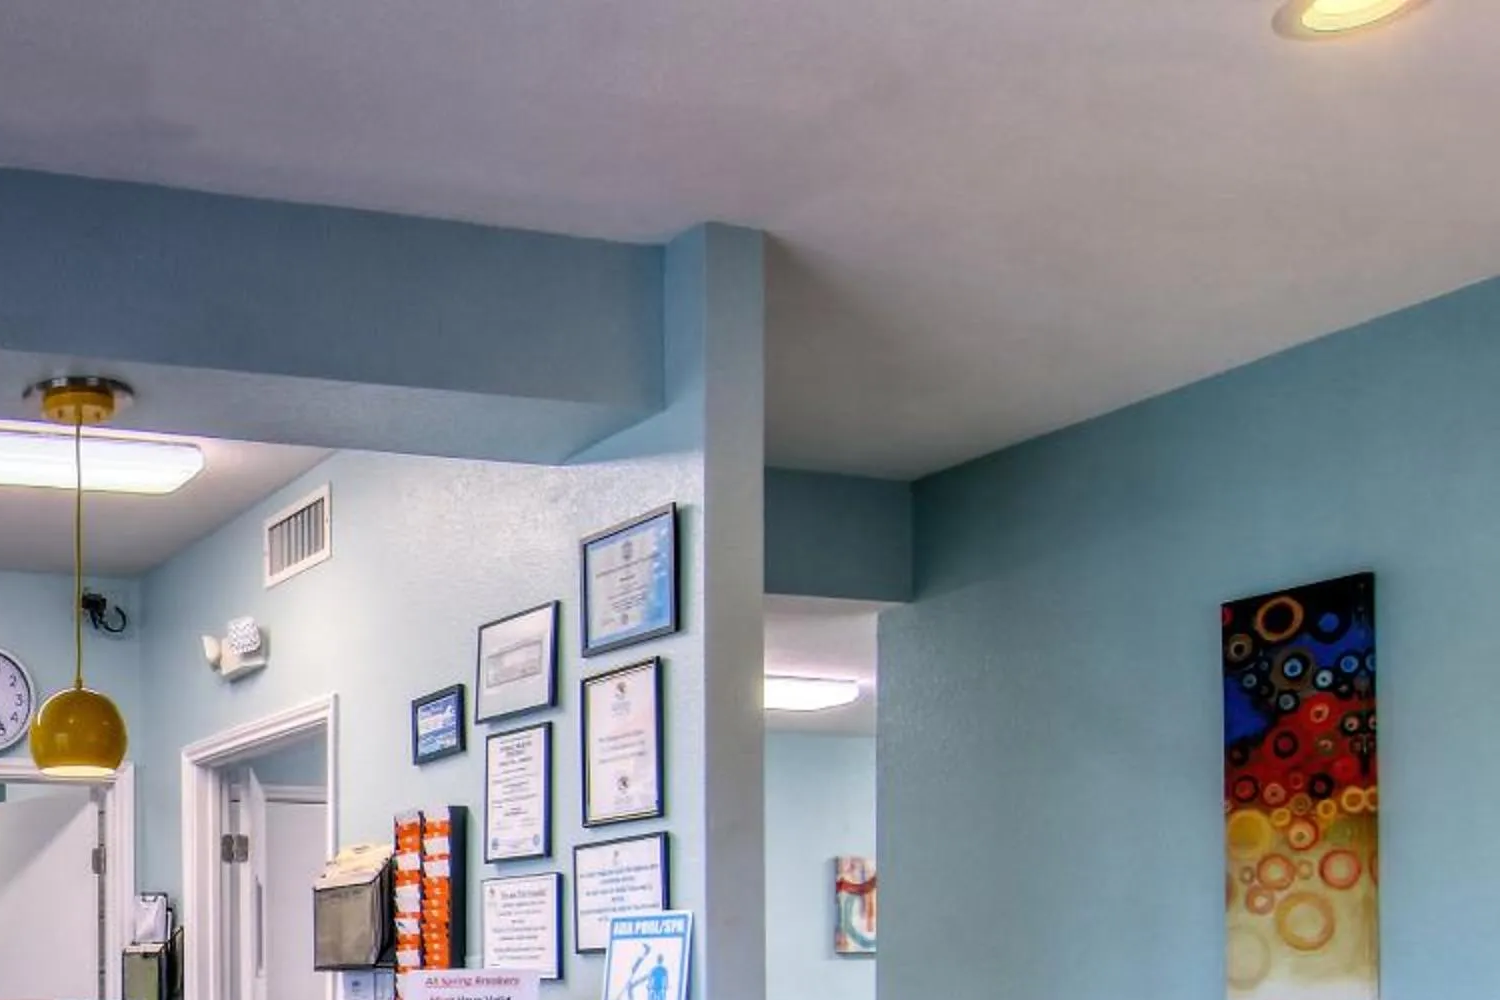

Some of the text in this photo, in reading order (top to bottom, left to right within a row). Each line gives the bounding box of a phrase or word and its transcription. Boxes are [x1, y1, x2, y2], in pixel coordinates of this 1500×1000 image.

[9, 673, 17, 687] 2
[14, 693, 23, 707] 3
[10, 711, 19, 723] 4
